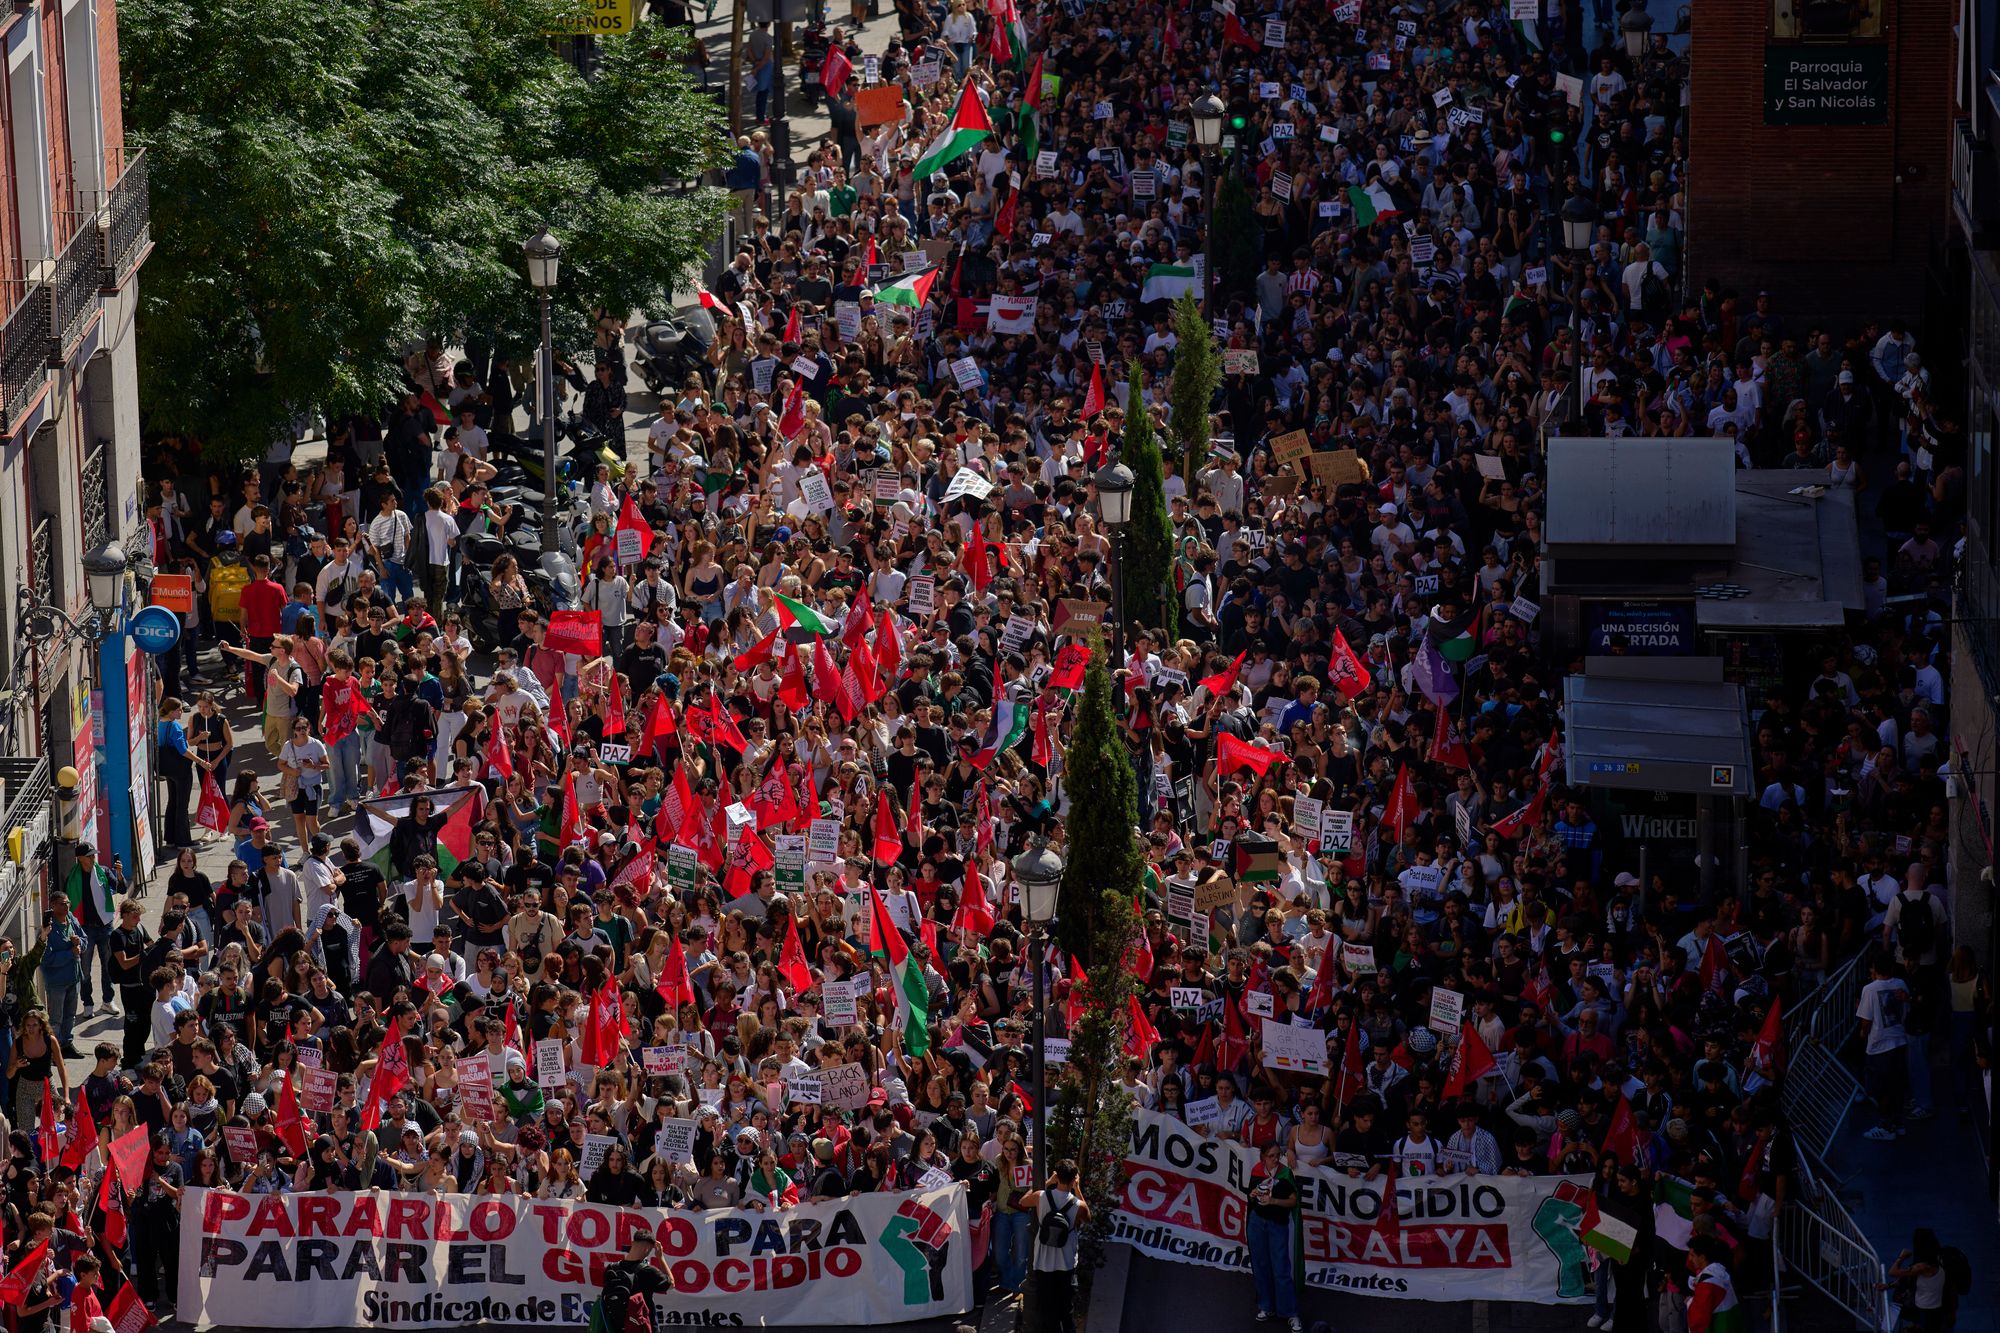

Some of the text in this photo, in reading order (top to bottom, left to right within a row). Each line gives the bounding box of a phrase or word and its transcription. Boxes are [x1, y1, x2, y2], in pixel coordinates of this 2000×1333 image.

[1335, 5, 1353, 19] PAZ
[1398, 22, 1416, 33] PAZ
[1789, 60, 1863, 77] Parroquia
[1784, 77, 1868, 91] El Salvador
[1291, 86, 1306, 100] PAZ
[1775, 94, 1876, 111] y San Nicolás
[1448, 109, 1469, 125] PAZ
[1275, 126, 1292, 137] PAZ
[1156, 161, 1170, 177] PAZ
[1103, 303, 1125, 318] PAZ
[1242, 531, 1264, 548] PAZ
[159, 587, 190, 597] Mundo
[1416, 577, 1437, 593] PAZ
[1074, 612, 1096, 622] LIBRE
[134, 626, 174, 638] DIGI
[1601, 620, 1680, 634] UNA DECISIÓN
[1601, 633, 1680, 647] AERTADA
[602, 746, 629, 762] PAZ
[1156, 776, 1169, 797] PAZ
[1323, 835, 1350, 850] PAZ
[1172, 990, 1200, 1007] PAZ
[269, 1010, 290, 1021] EVERLAST
[1198, 1002, 1223, 1020] PAZ
[467, 1065, 478, 1074] NO
[828, 1066, 861, 1085] BACK
[314, 1077, 324, 1086] NO
[460, 1071, 488, 1083] PASARÁ
[304, 1083, 333, 1094] PASARÁ
[468, 1090, 479, 1098] NO
[234, 1134, 245, 1142] NO
[666, 1137, 688, 1145] GLOBAL
[663, 1141, 689, 1150] FLOTILLA
[1296, 1175, 1505, 1221] ENOCIDIO
[203, 1191, 866, 1257] PARARLO TODO PARA
[1111, 1170, 1202, 1226] GA
[1434, 1228, 1506, 1264] YA
[1106, 1213, 1222, 1262] Sindicato
[1306, 1267, 1408, 1293] diantes
[200, 1236, 862, 1293] PARAR EL GEOCIDIO
[363, 1290, 743, 1328] Sindicato de Esiantes
